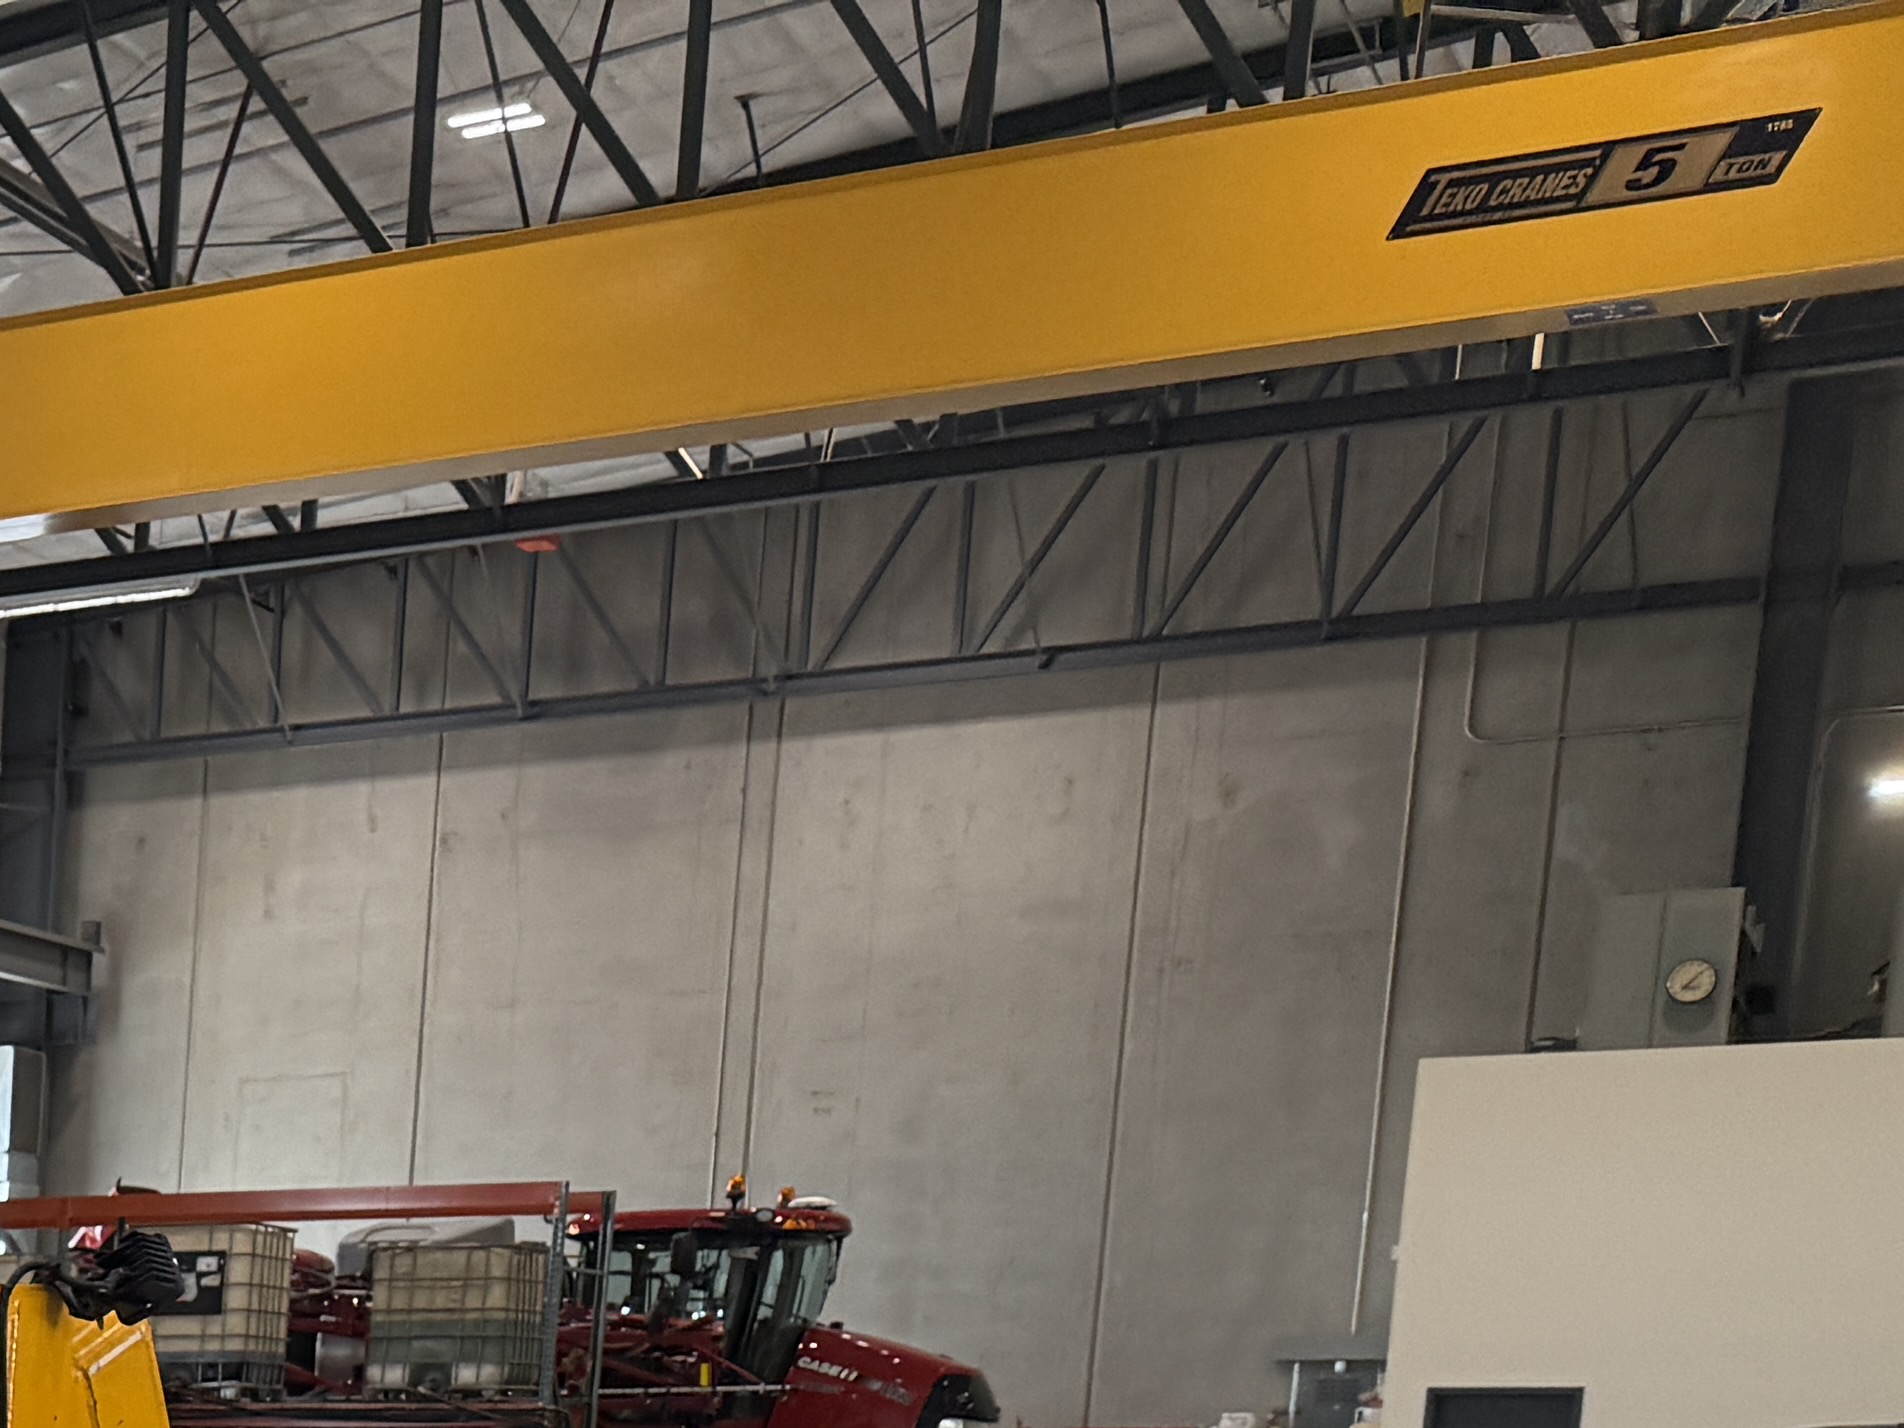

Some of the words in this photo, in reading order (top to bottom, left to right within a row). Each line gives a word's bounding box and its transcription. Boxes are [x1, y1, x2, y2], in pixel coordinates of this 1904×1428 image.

[1420, 172, 1488, 217] TEKO
[1490, 168, 1593, 206] CRANES
[1625, 143, 1689, 192] 5
[1723, 157, 1775, 178] TON
